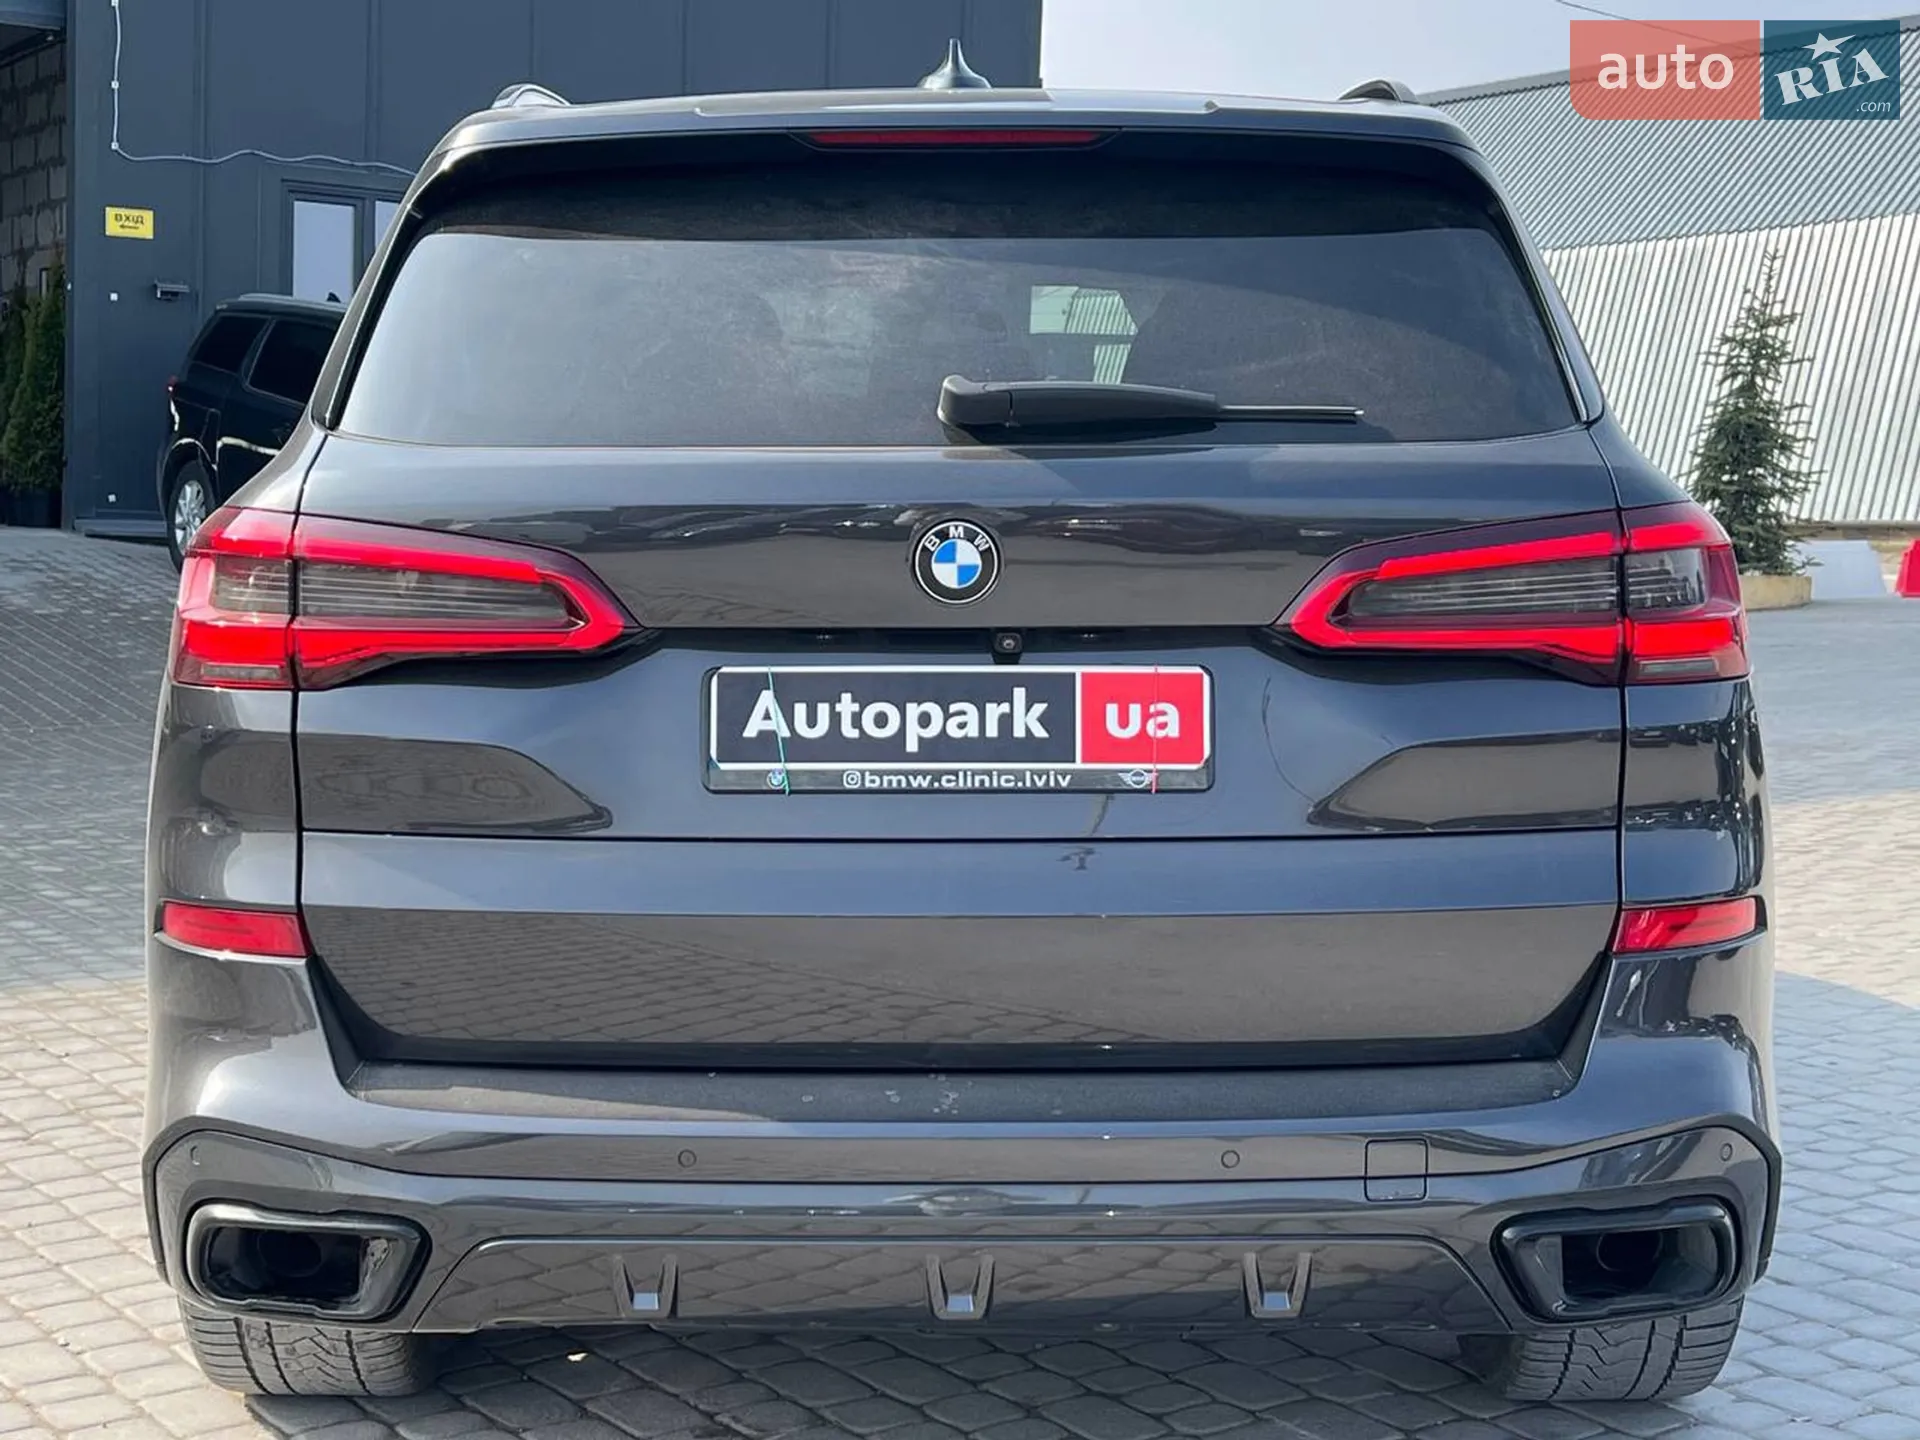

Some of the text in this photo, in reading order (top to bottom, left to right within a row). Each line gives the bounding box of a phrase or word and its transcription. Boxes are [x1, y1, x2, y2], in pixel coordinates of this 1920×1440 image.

[924, 526, 990, 552] BMW
[742, 687, 1181, 752] Autopark ua
